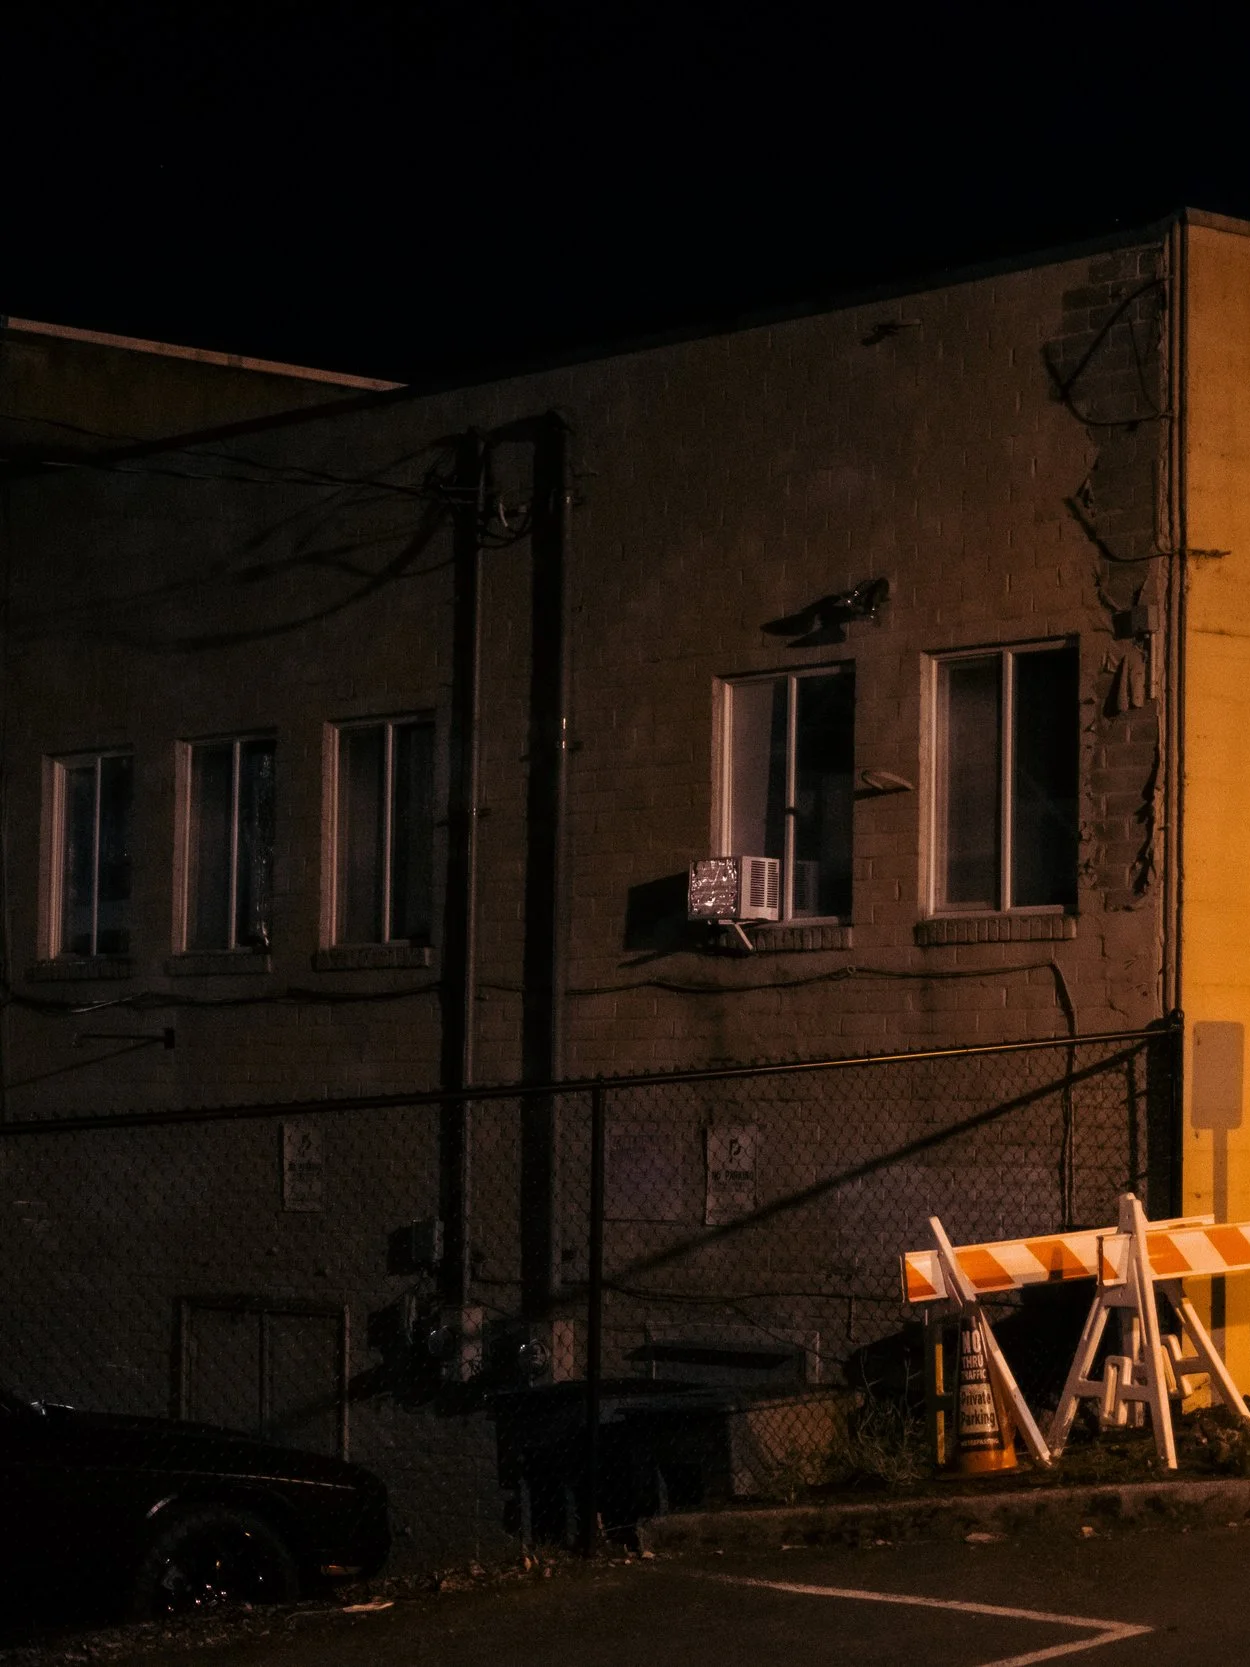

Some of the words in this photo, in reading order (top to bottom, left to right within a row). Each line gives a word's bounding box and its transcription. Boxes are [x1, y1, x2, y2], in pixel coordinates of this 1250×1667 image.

[962, 1329, 981, 1354] NO
[961, 1354, 984, 1369] THRU
[960, 1391, 991, 1405] Private
[960, 1408, 995, 1427] Parking
